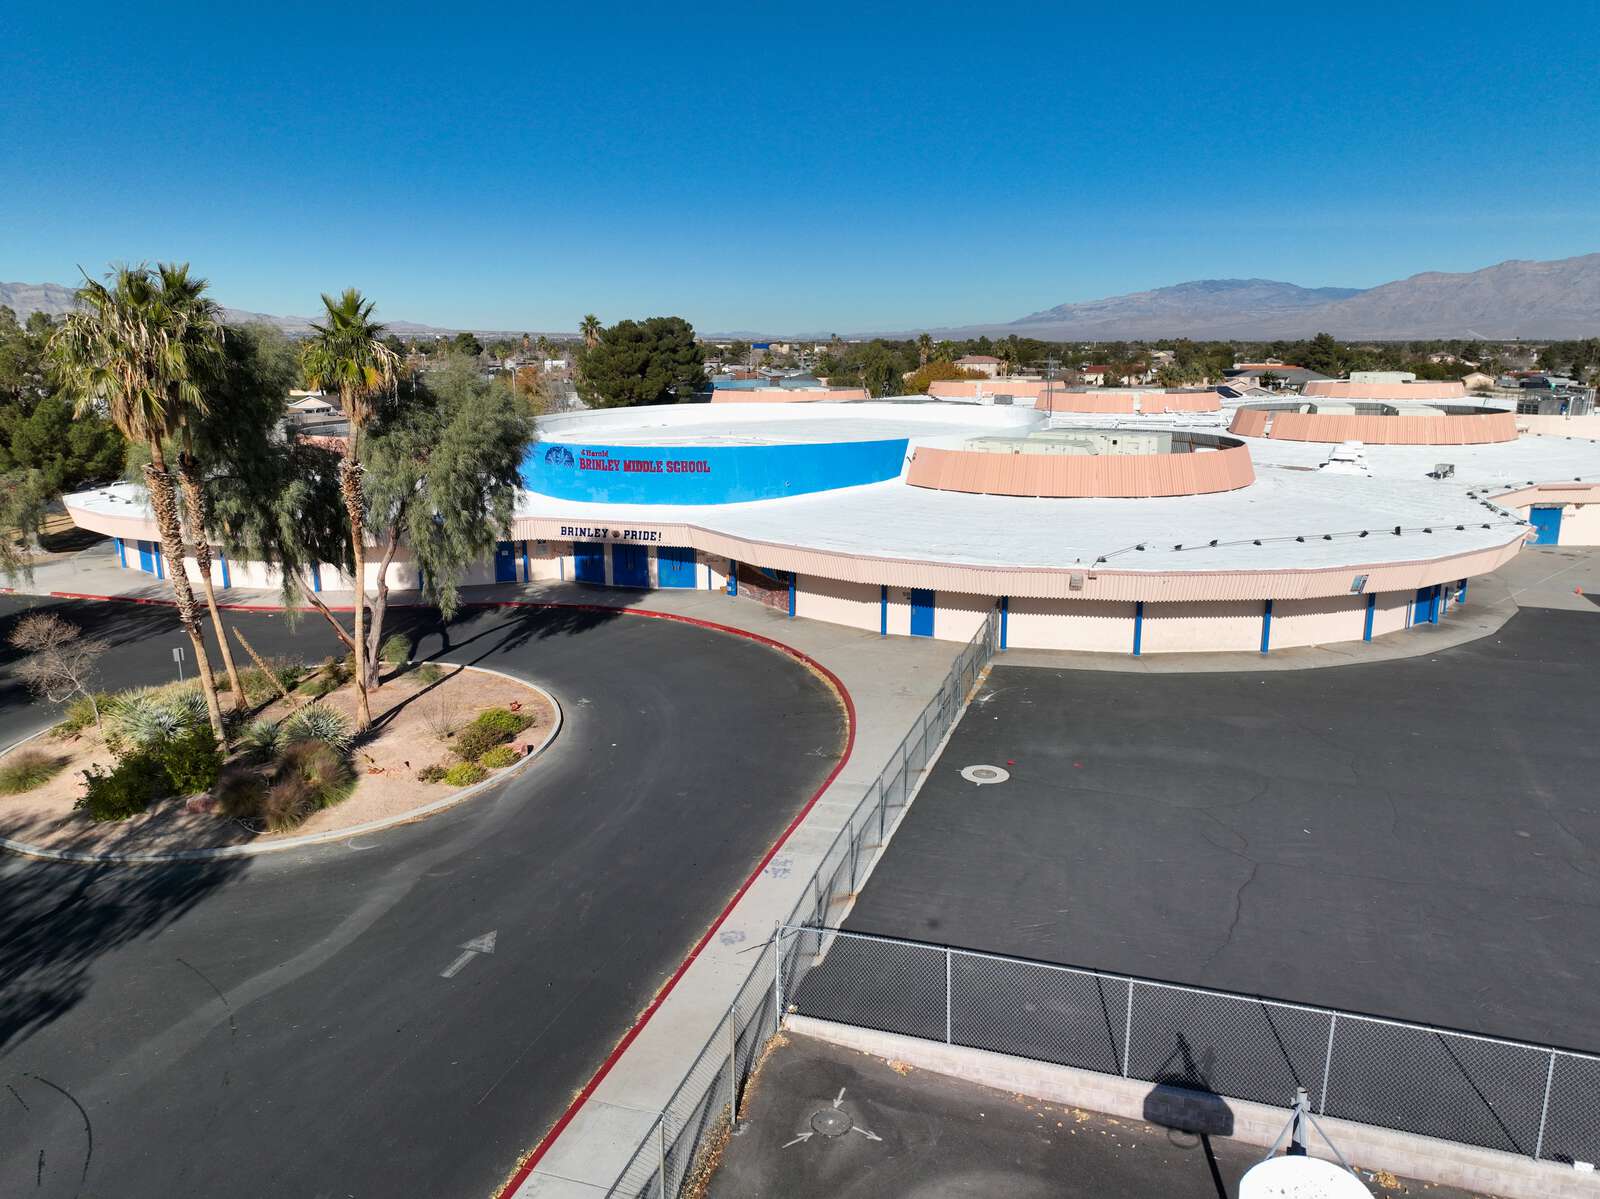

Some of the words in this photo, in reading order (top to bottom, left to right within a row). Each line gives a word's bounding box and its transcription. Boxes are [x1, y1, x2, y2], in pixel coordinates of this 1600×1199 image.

[579, 458, 620, 471] BRINLEY
[623, 460, 663, 472] MIDDLE
[666, 461, 710, 473] SCHOOL
[561, 526, 608, 538] BRINLEY
[623, 530, 661, 541] PRIDE!
